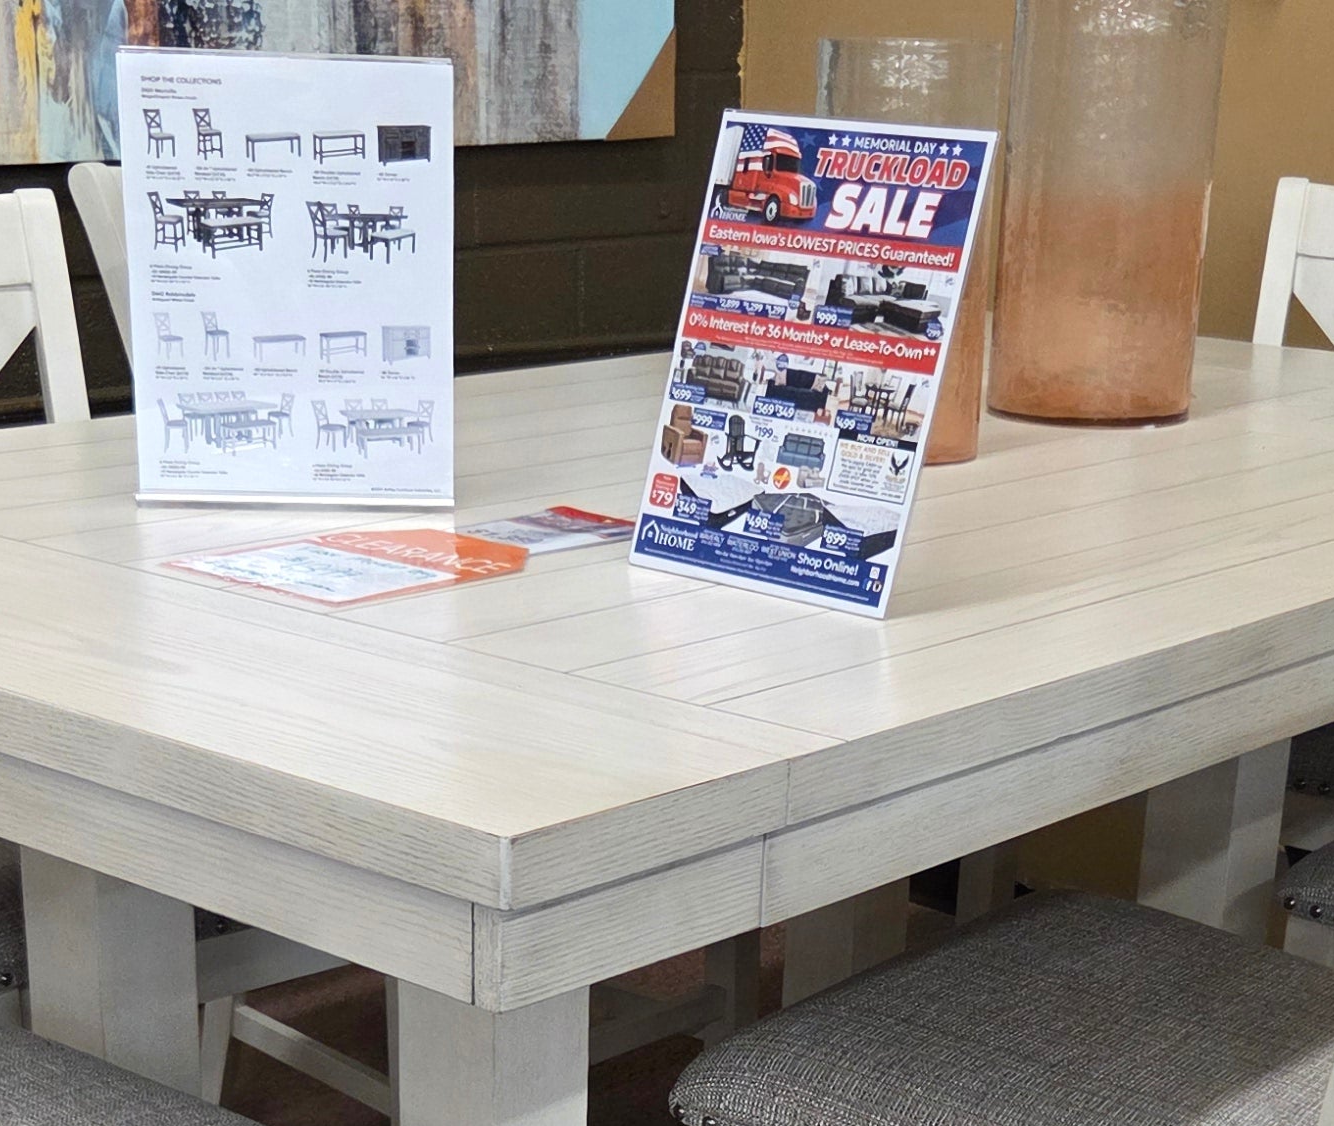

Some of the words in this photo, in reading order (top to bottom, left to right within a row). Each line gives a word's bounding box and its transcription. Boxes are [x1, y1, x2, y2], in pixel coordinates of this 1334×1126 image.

[175, 77, 222, 85] COLLECTIONS
[854, 136, 912, 153] MEMORIAL
[913, 141, 937, 155] DAY
[814, 147, 970, 190] TRUCKLOAD
[825, 183, 945, 239] SALE
[708, 225, 750, 242] Eastern
[752, 230, 786, 246] Iowa's
[787, 233, 836, 252] LOWEST
[837, 240, 880, 258] PRICES
[880, 246, 956, 267] Guaranteed!
[816, 311, 838, 325] $999
[689, 312, 708, 327] 0%
[708, 315, 749, 334] Interest
[750, 321, 767, 336] for
[768, 324, 782, 338] 36
[830, 337, 842, 348] or
[672, 387, 692, 400] $699
[754, 400, 775, 415] $369
[775, 404, 795, 418] $349
[754, 425, 774, 438] $199
[835, 415, 856, 430] $499
[652, 489, 674, 506] $79
[675, 499, 698, 514] $349
[746, 512, 769, 530] $498
[658, 533, 696, 551] HOME
[823, 529, 847, 546] $899
[326, 533, 512, 575] CLEARANCE
[797, 552, 822, 570] Shop
[823, 558, 859, 576] Online!
